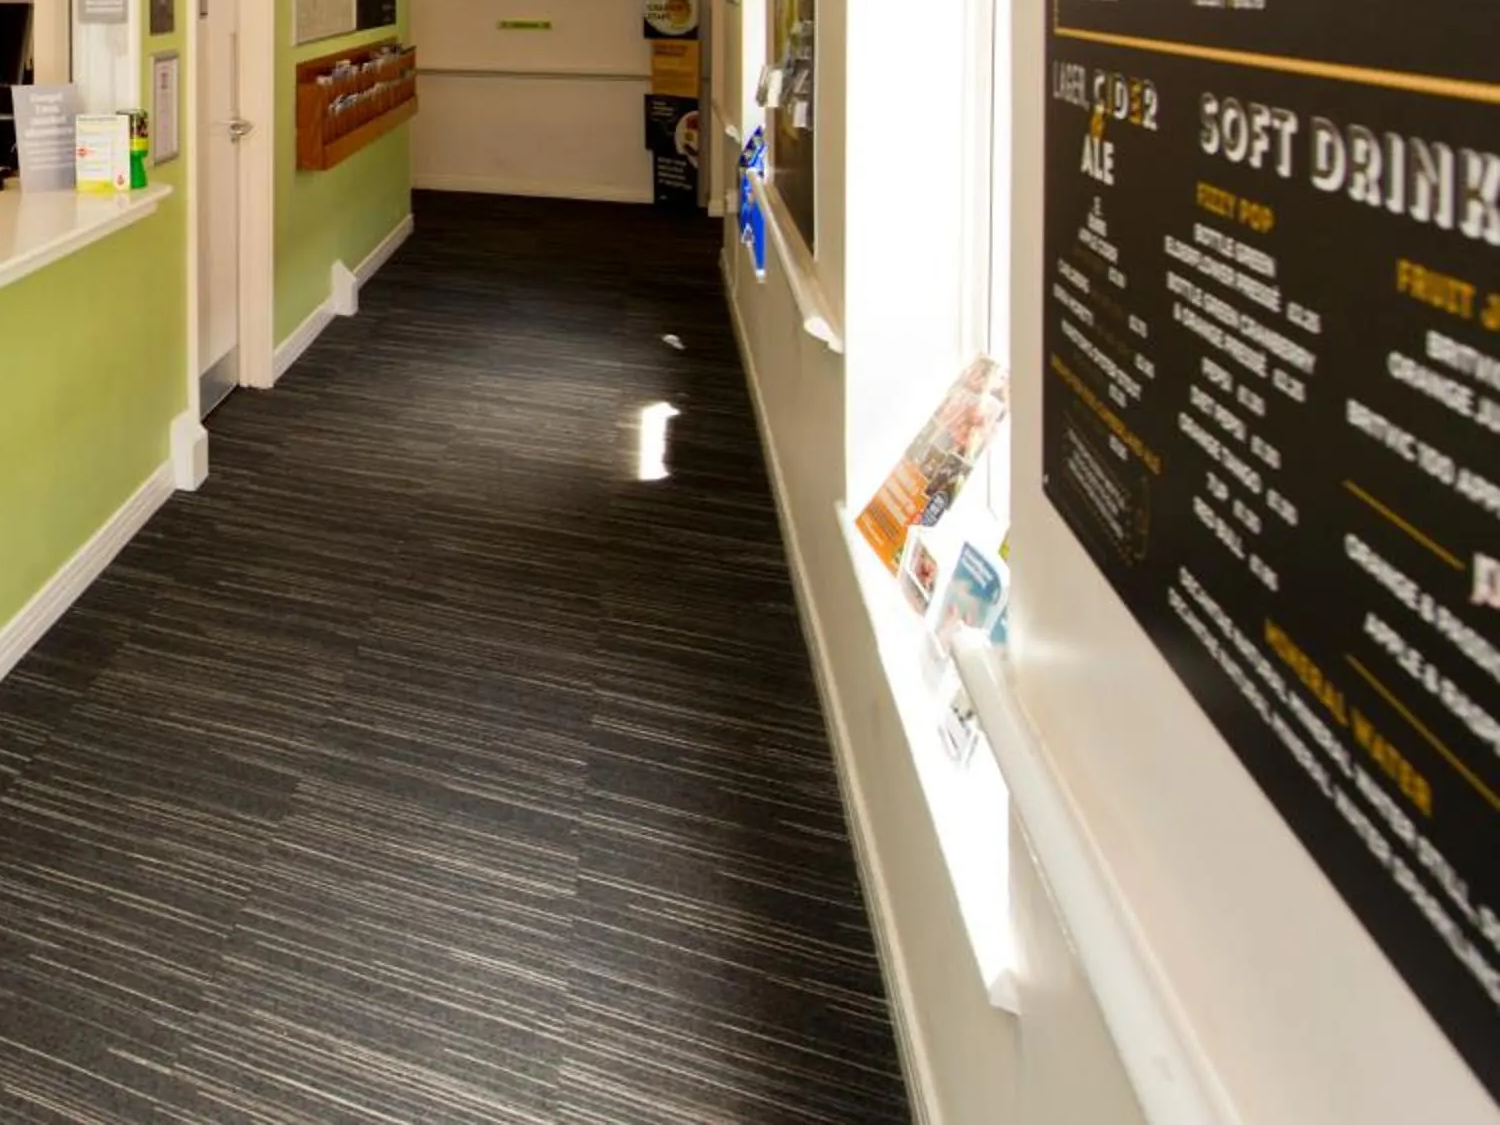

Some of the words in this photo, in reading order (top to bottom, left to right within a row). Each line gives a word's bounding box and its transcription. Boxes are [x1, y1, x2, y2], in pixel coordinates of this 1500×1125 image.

[1080, 133, 1115, 186] ALE
[1200, 91, 1299, 179] SOFT
[1396, 258, 1475, 318] FRUIT
